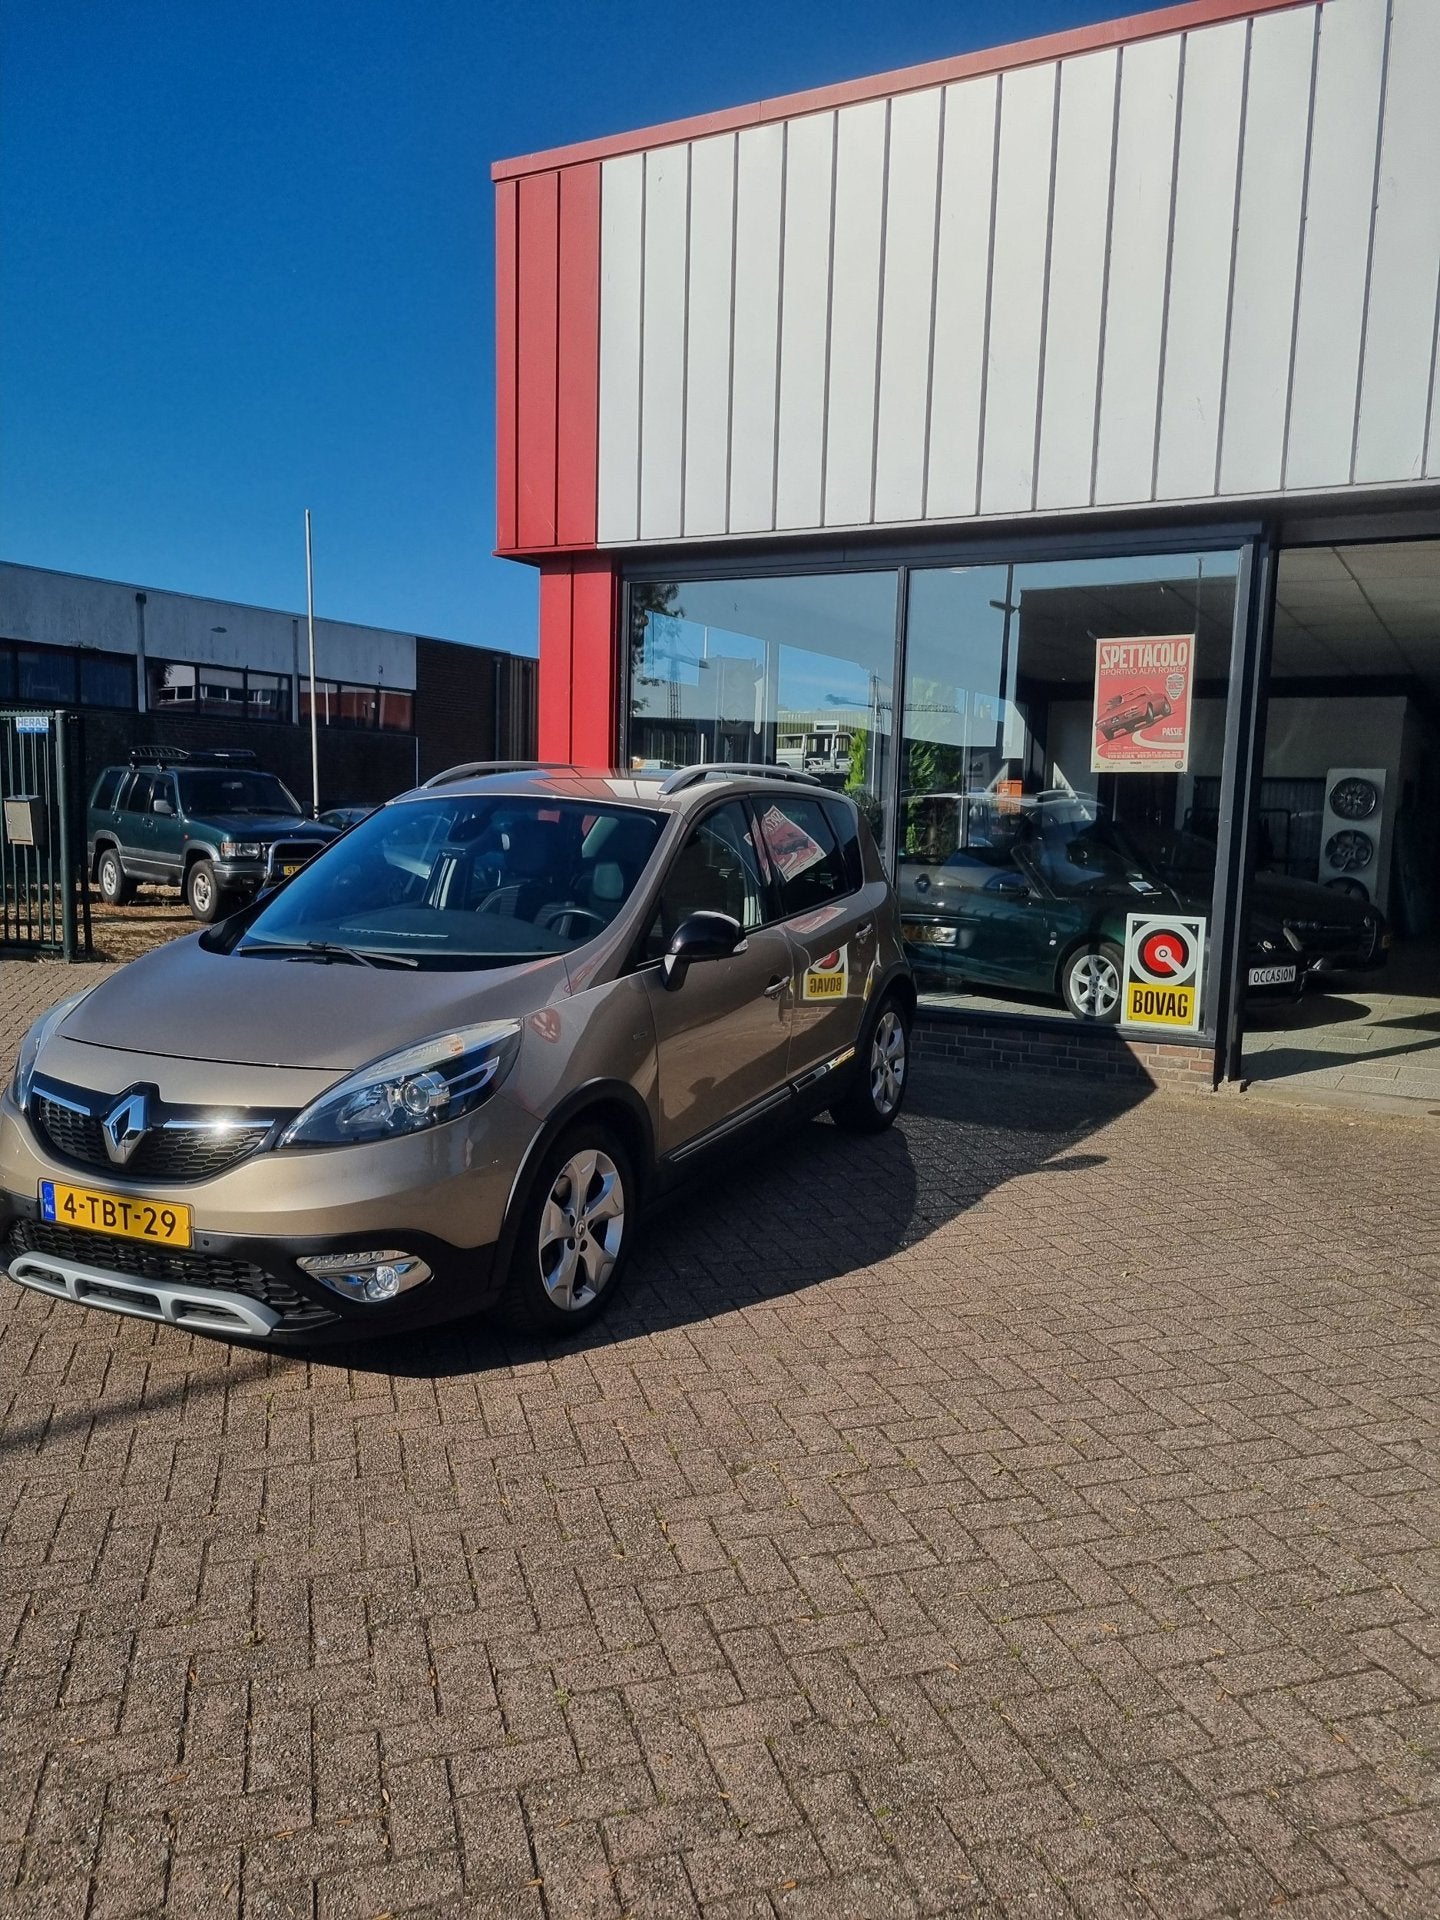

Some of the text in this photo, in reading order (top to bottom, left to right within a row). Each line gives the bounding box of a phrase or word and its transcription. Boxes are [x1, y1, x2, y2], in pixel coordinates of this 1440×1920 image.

[1101, 642, 1188, 669] SPETTACOLO
[1101, 666, 1187, 676] SPORTIVO ALFA ROMEO
[17, 717, 48, 727] HERAS
[1253, 969, 1295, 983] OCCASION
[1133, 990, 1189, 1018] BOVAG
[63, 1193, 176, 1238] 4-TBT-29
